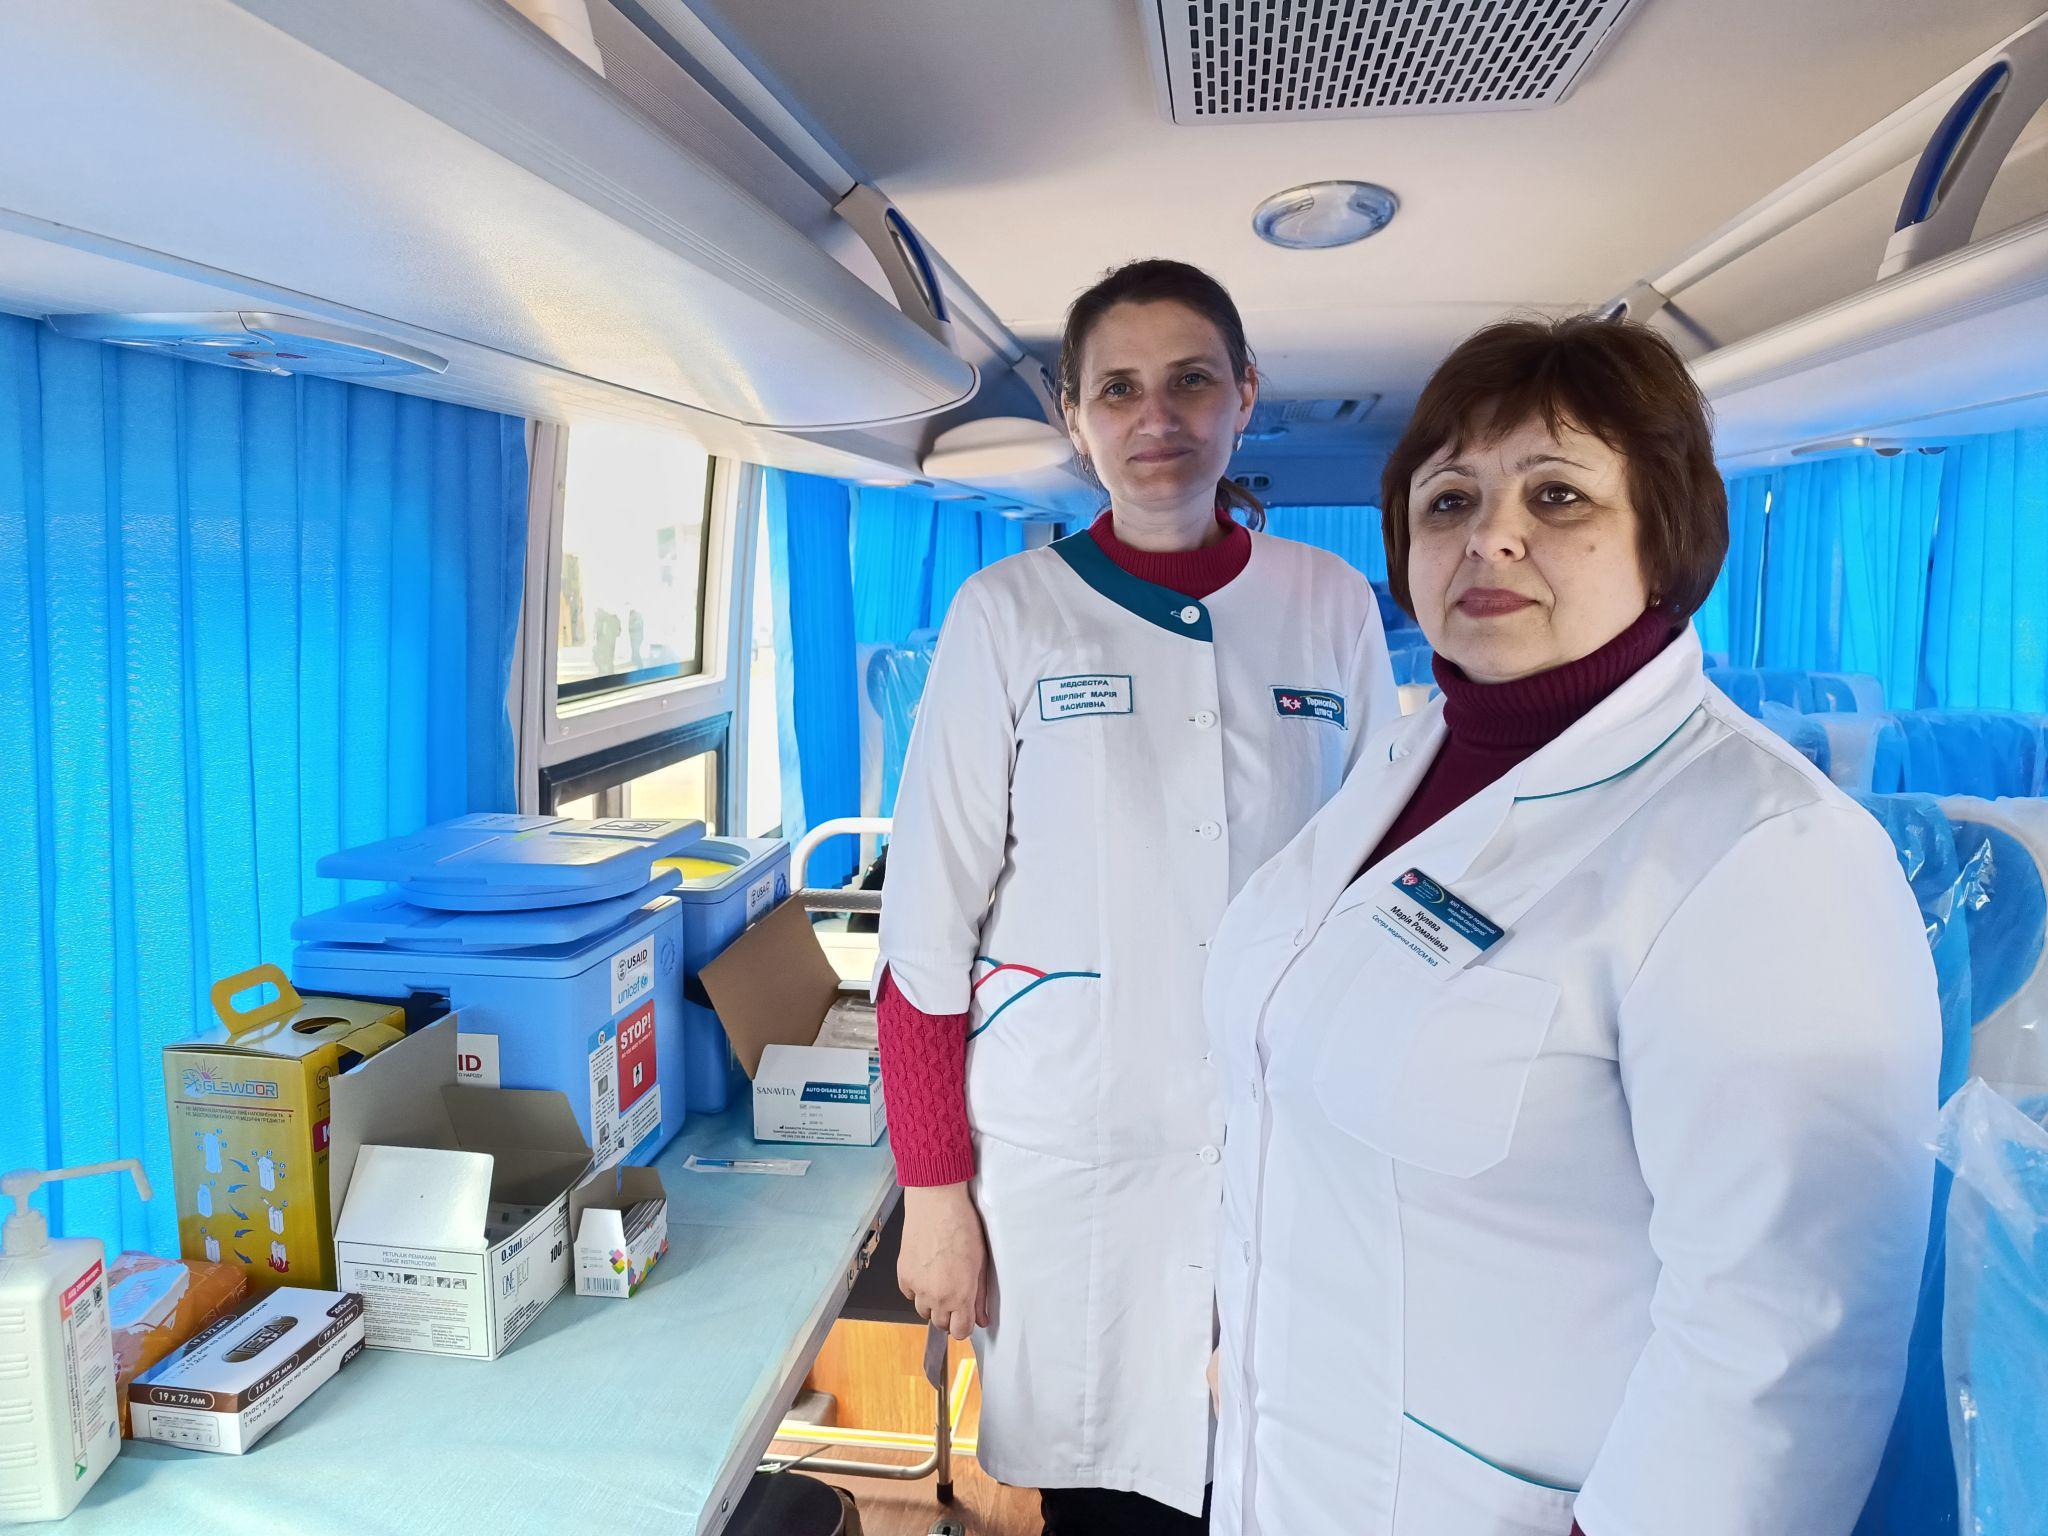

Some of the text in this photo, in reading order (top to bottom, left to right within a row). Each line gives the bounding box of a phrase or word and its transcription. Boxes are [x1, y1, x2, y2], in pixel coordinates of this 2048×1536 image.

[1060, 680, 1109, 688] МЕДСЕСТРА
[1050, 692, 1086, 702] ЕМІРЛІНГ
[1060, 701, 1105, 711] ВАСИЛІВНА
[1390, 906, 1448, 952] Марія Романівна
[1415, 911, 1440, 932] Кулява
[1372, 914, 1389, 929] Сестра
[1388, 927, 1410, 945] медична
[1408, 944, 1428, 960] АЗПСМ
[627, 949, 648, 969] USAID
[618, 976, 640, 1004] unicef
[621, 1012, 651, 1050] STOP!
[203, 1081, 276, 1096] GLEWOOR
[756, 1086, 796, 1096] SANAVITA
[501, 1238, 522, 1262] 0.3ml
[550, 1240, 562, 1263] 100
[324, 1330, 331, 1340] 19
[336, 1320, 343, 1330] 72
[344, 1344, 362, 1362] 200шт
[243, 1398, 270, 1419] Пластир
[271, 1387, 282, 1399] для
[282, 1379, 293, 1390] ран
[302, 1347, 330, 1373] полімерній
[331, 1332, 348, 1348] основі
[256, 1383, 264, 1394] 19
[272, 1372, 280, 1382] 72
[159, 1392, 168, 1400] 19
[179, 1394, 189, 1403] 72
